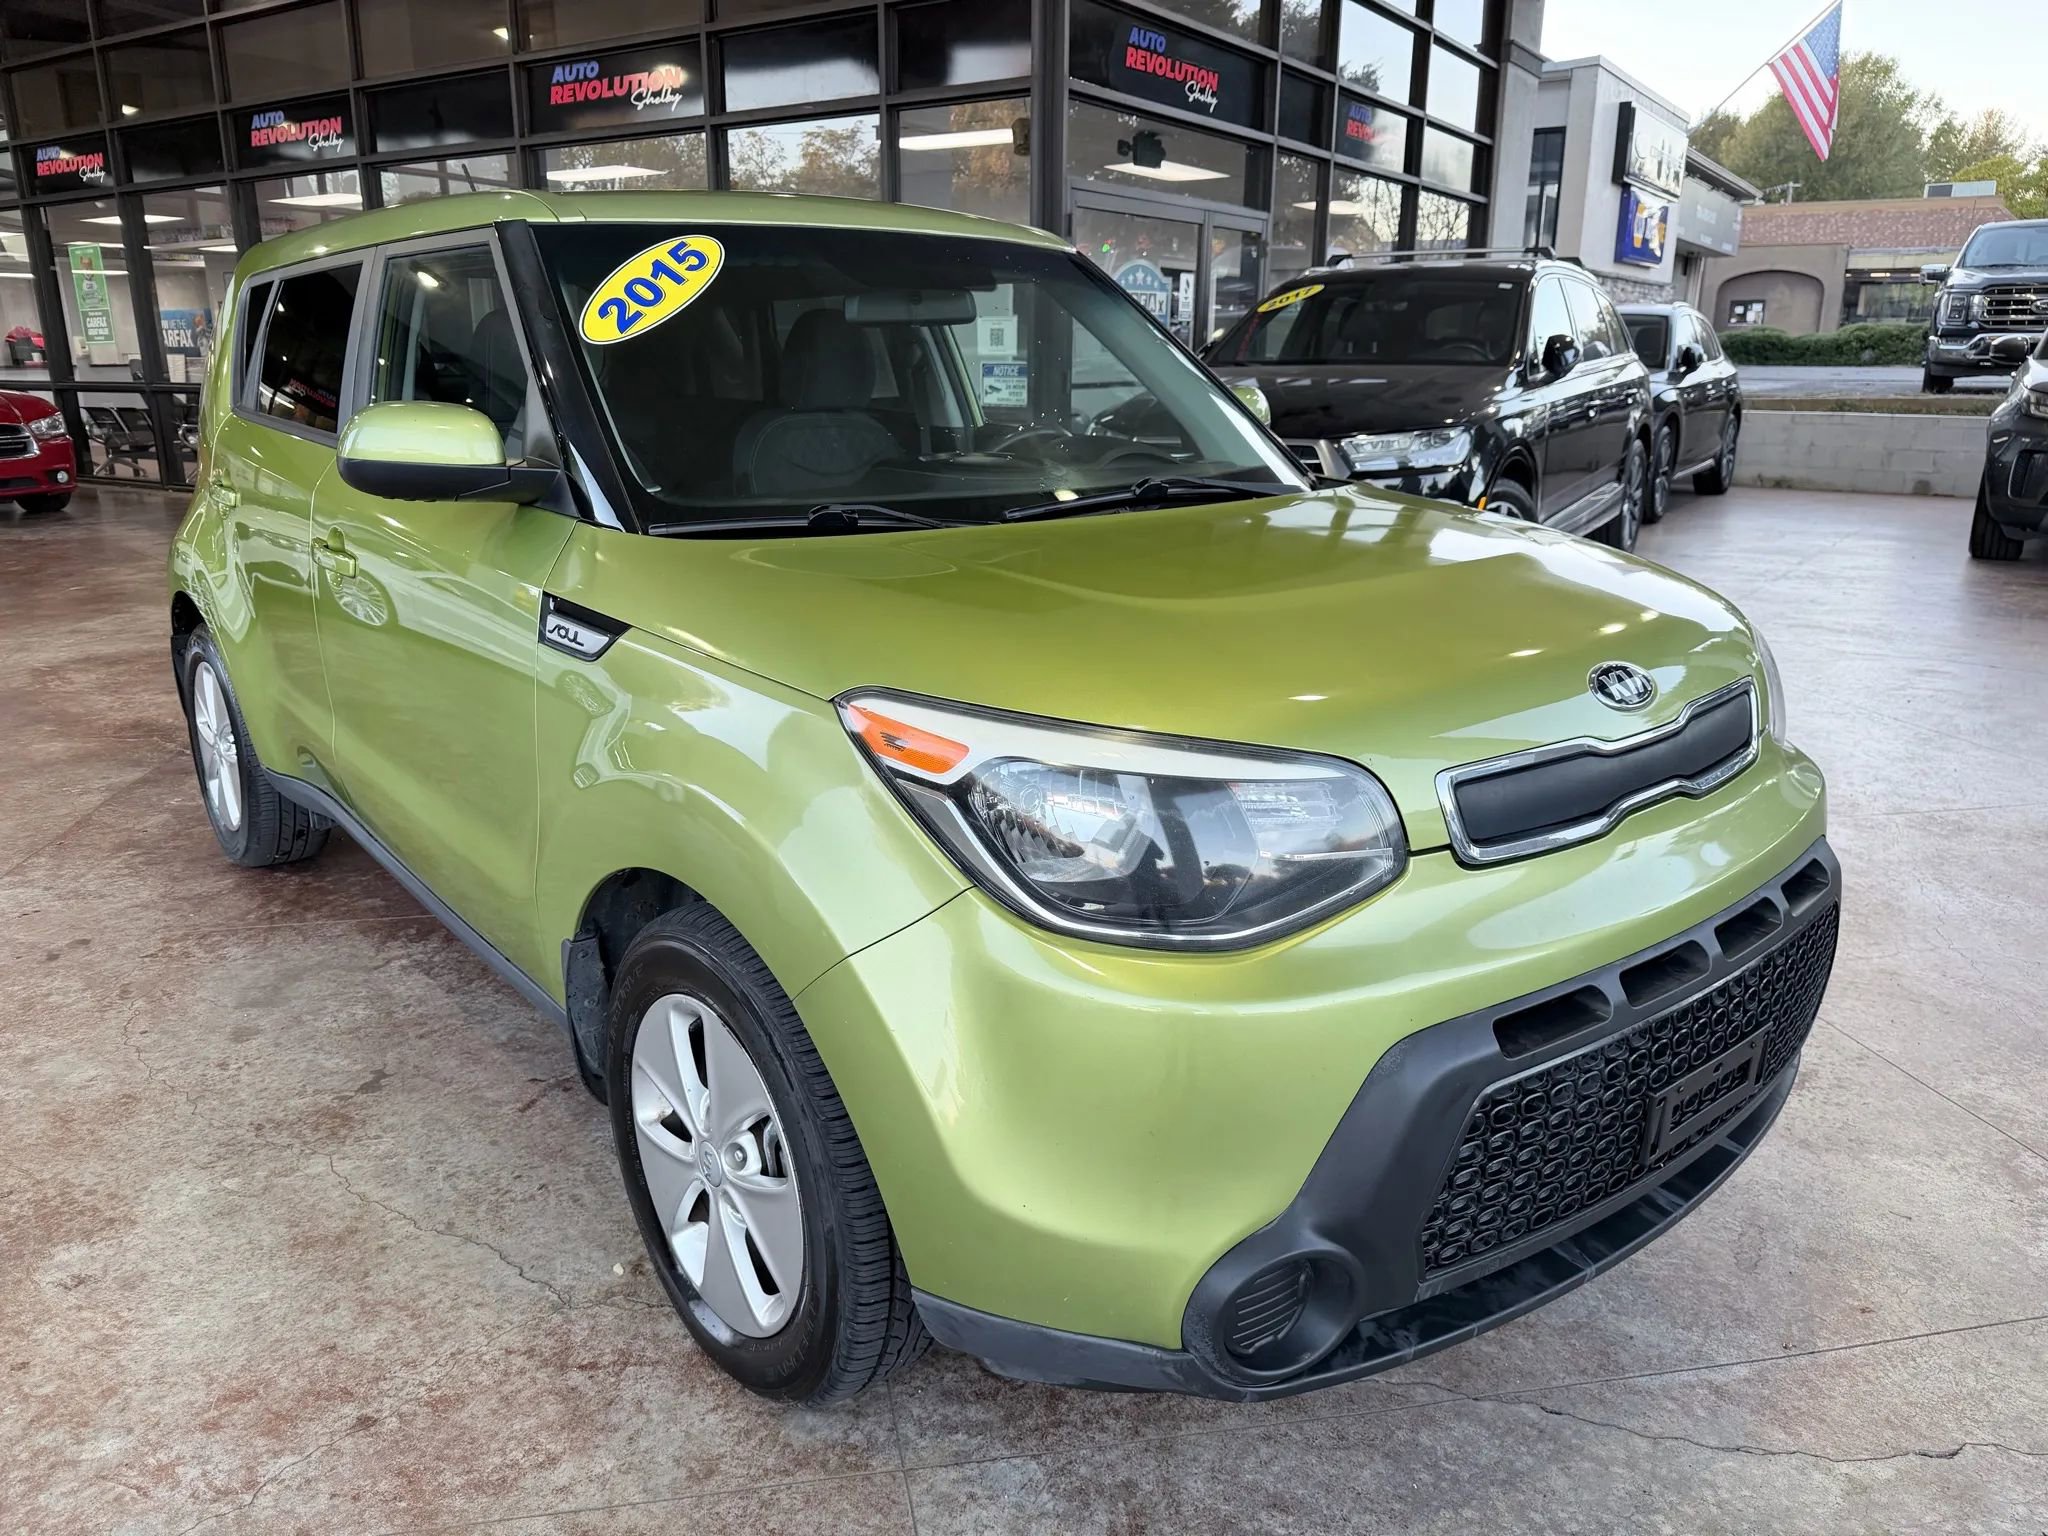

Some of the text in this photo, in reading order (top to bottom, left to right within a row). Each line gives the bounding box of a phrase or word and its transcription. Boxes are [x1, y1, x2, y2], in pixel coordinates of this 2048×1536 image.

[1129, 27, 1166, 53] AUTO
[551, 61, 600, 83] AUTO
[1126, 46, 1218, 92] REVOLUTION
[550, 66, 682, 104] REVOLUTION
[630, 84, 683, 112] Shelby
[1185, 80, 1218, 114] Shelby
[251, 110, 285, 130] AUTO
[251, 116, 342, 147] REVOLUTION
[36, 145, 61, 161] AUTO
[308, 129, 345, 153] Shelby
[37, 151, 104, 177] REVOLUTION
[79, 162, 106, 184] Shelby
[597, 240, 710, 335] 2015
[162, 329, 195, 348] ARFAX
[992, 365, 1020, 377] NOTICE
[1598, 668, 1653, 702] KIA
